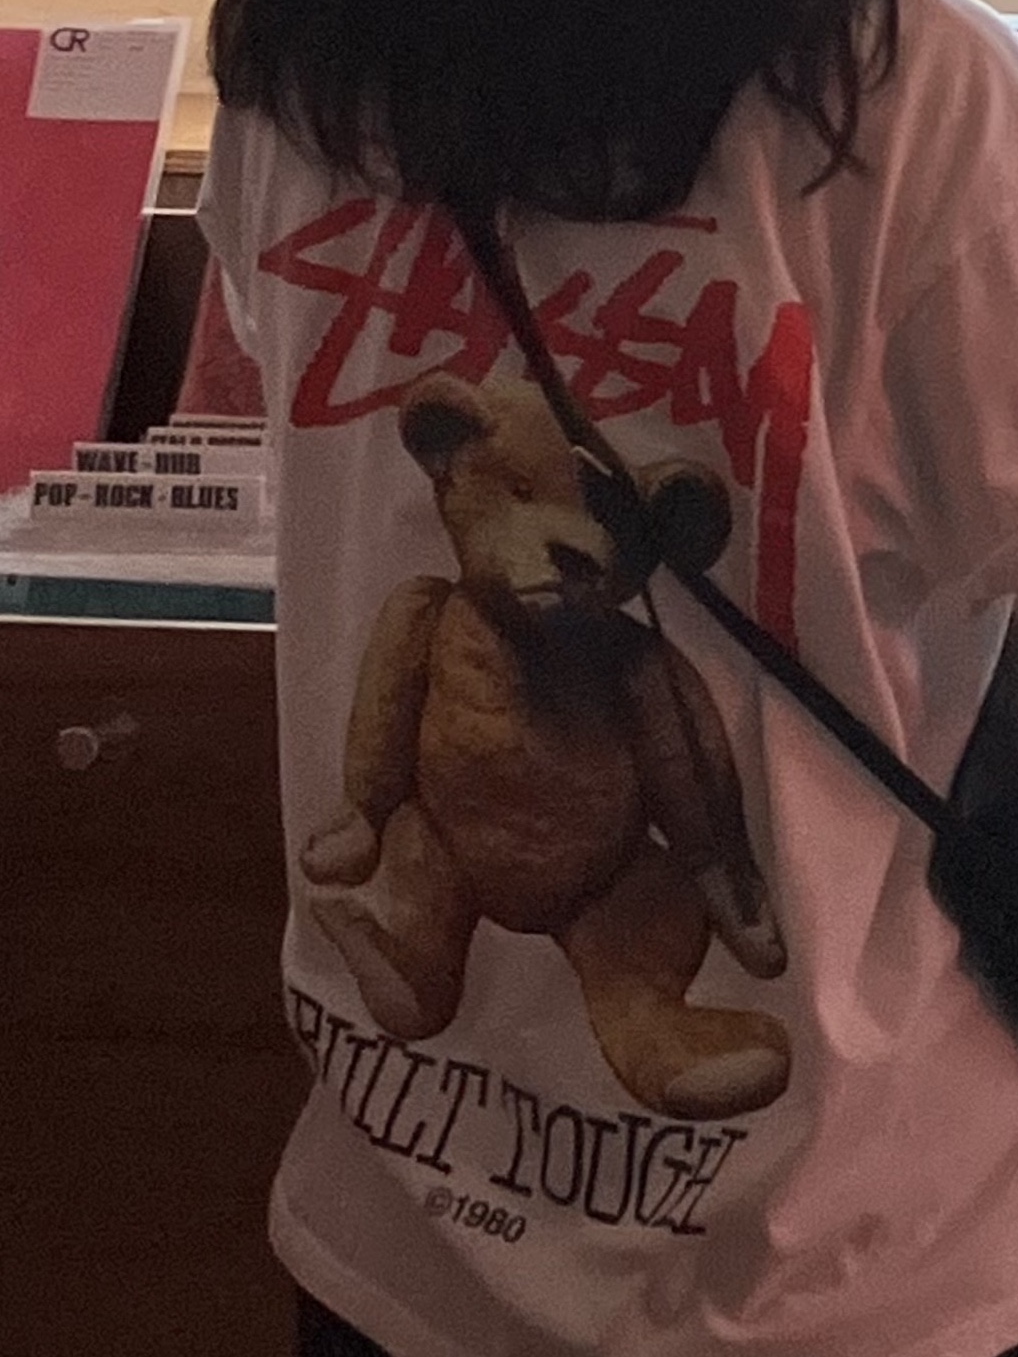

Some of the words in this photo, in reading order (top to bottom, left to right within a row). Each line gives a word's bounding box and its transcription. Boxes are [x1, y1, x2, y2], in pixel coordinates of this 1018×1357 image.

[50, 26, 91, 53] CR
[76, 450, 138, 473] WAVE
[34, 482, 77, 506] POP
[95, 484, 154, 507] ROCK
[171, 485, 239, 510] BLUES
[489, 1079, 749, 1235] TOUGH
